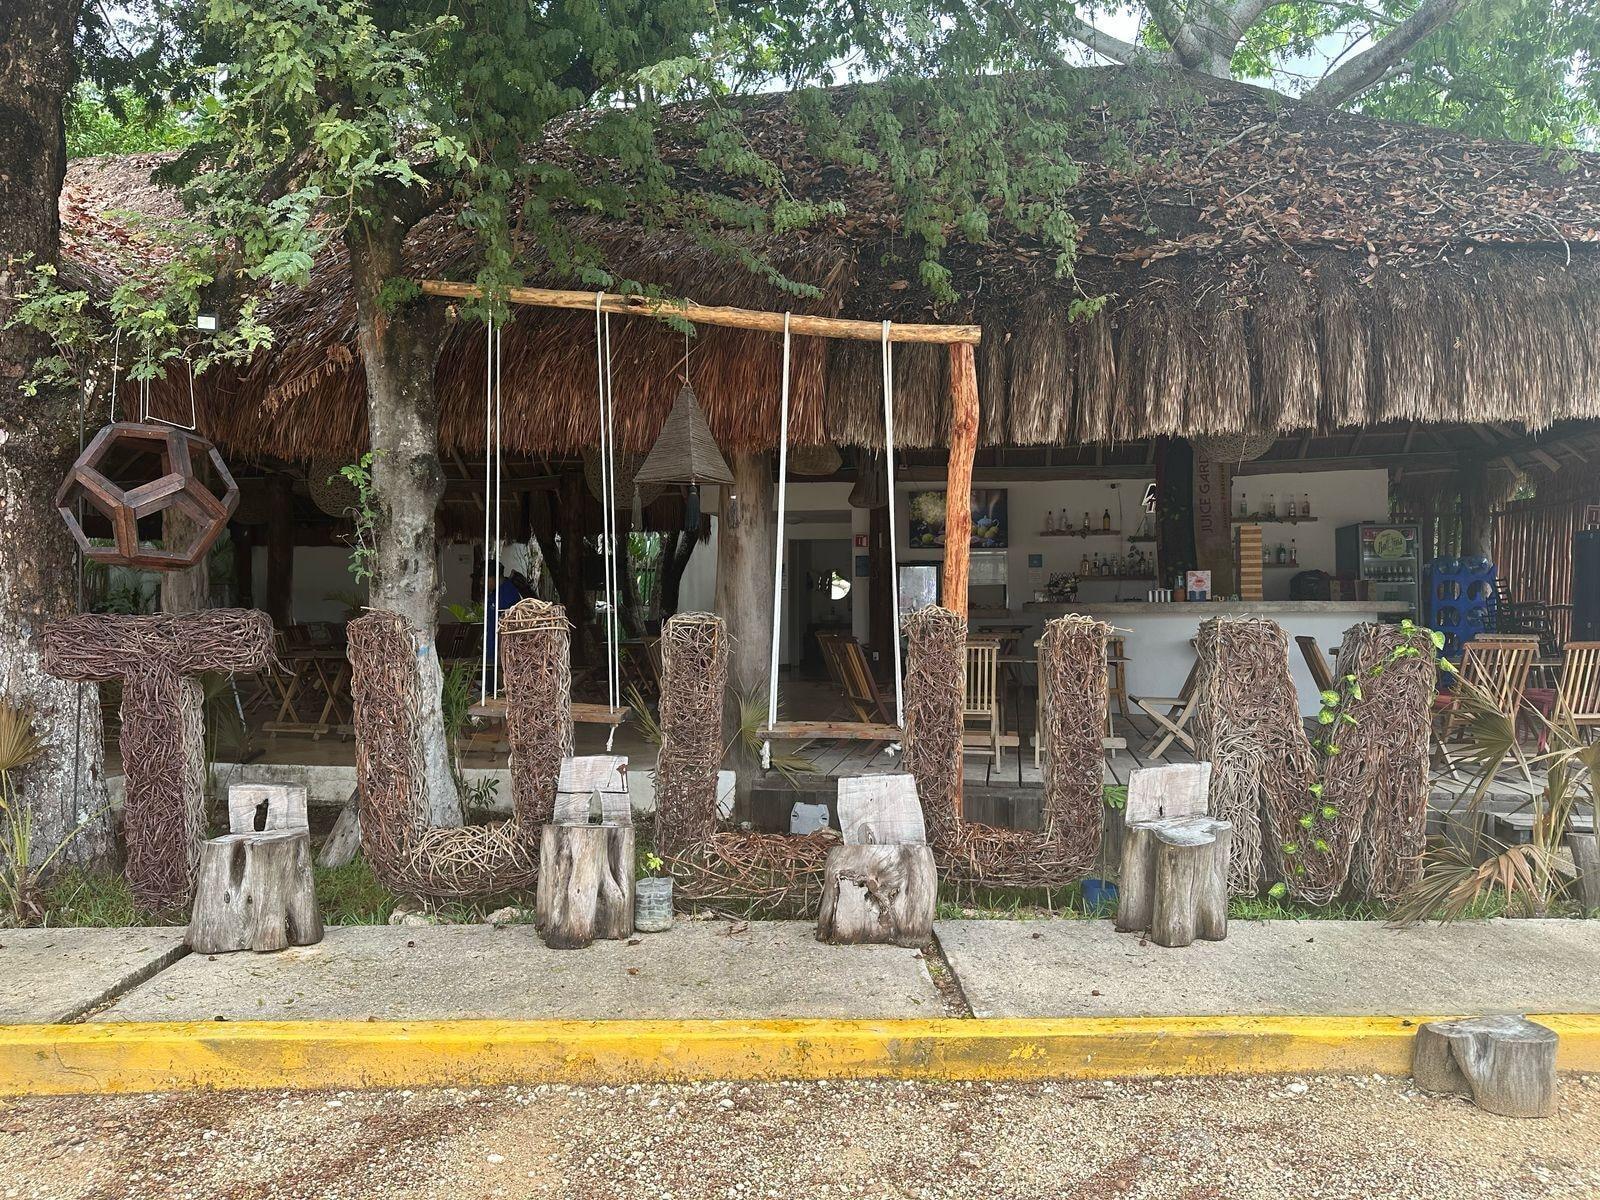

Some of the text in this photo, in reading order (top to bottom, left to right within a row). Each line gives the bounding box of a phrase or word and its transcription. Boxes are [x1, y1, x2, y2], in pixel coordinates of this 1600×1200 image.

[1199, 451, 1213, 534] JUICE GARD
[43, 602, 1434, 911] TULUM
